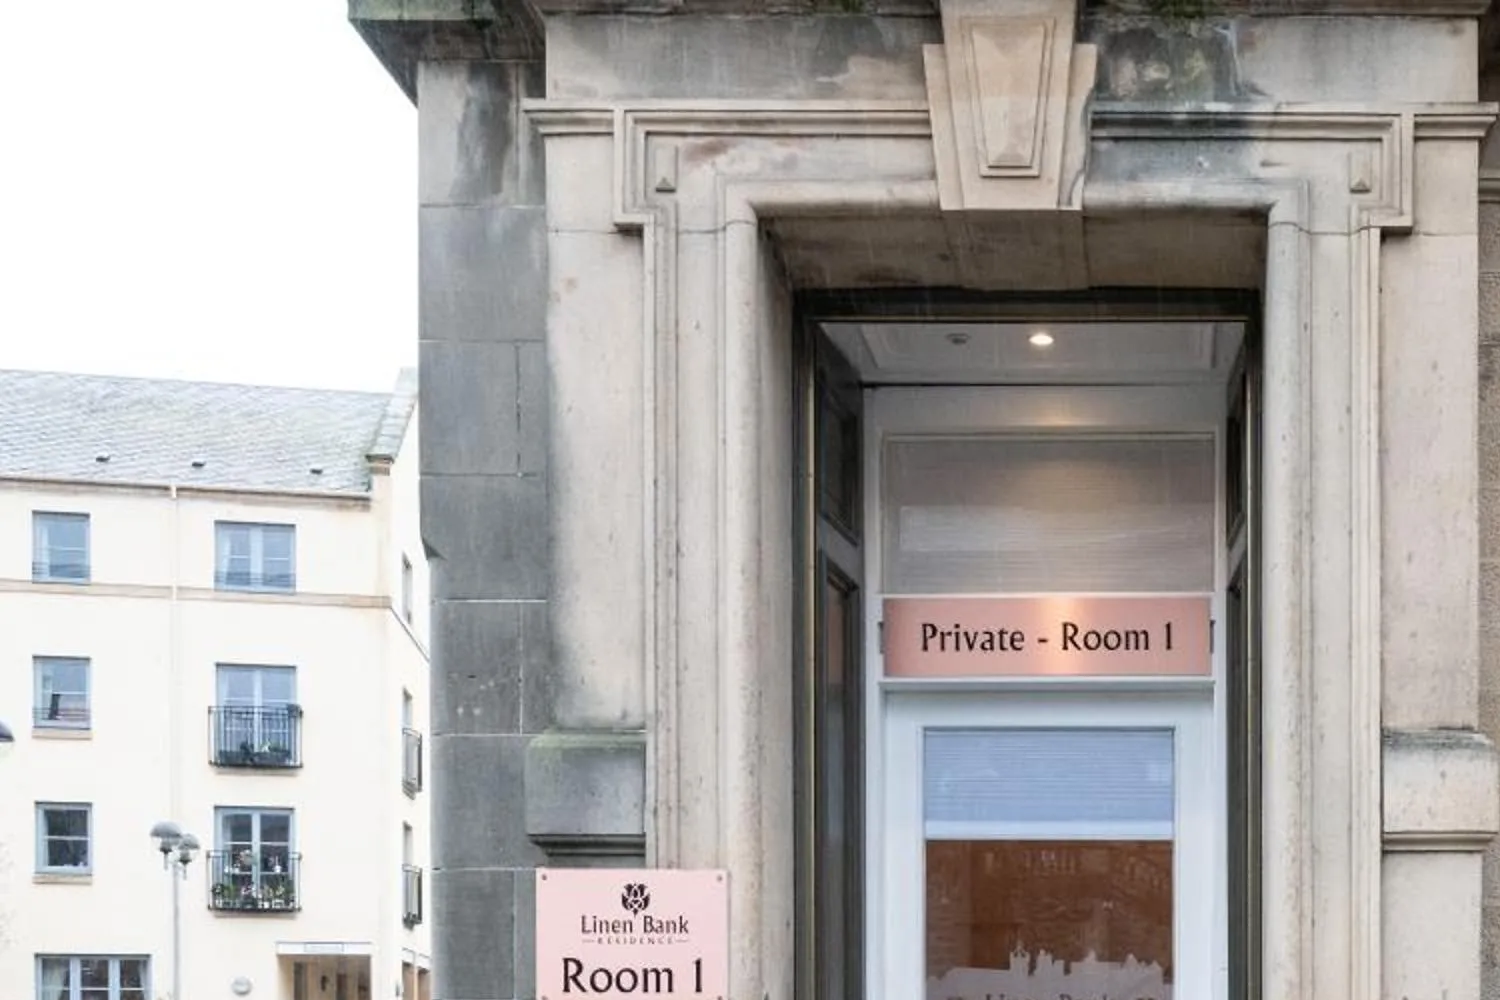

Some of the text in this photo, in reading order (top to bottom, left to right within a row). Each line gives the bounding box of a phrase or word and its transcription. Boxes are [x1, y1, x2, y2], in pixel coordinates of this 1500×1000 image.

[920, 623, 1025, 652] Private
[1060, 622, 1150, 651] Room
[1165, 621, 1173, 650] 1
[580, 915, 689, 934] Linen Bank
[597, 937, 673, 945] RESIDENCE
[562, 957, 702, 993] Room 1
